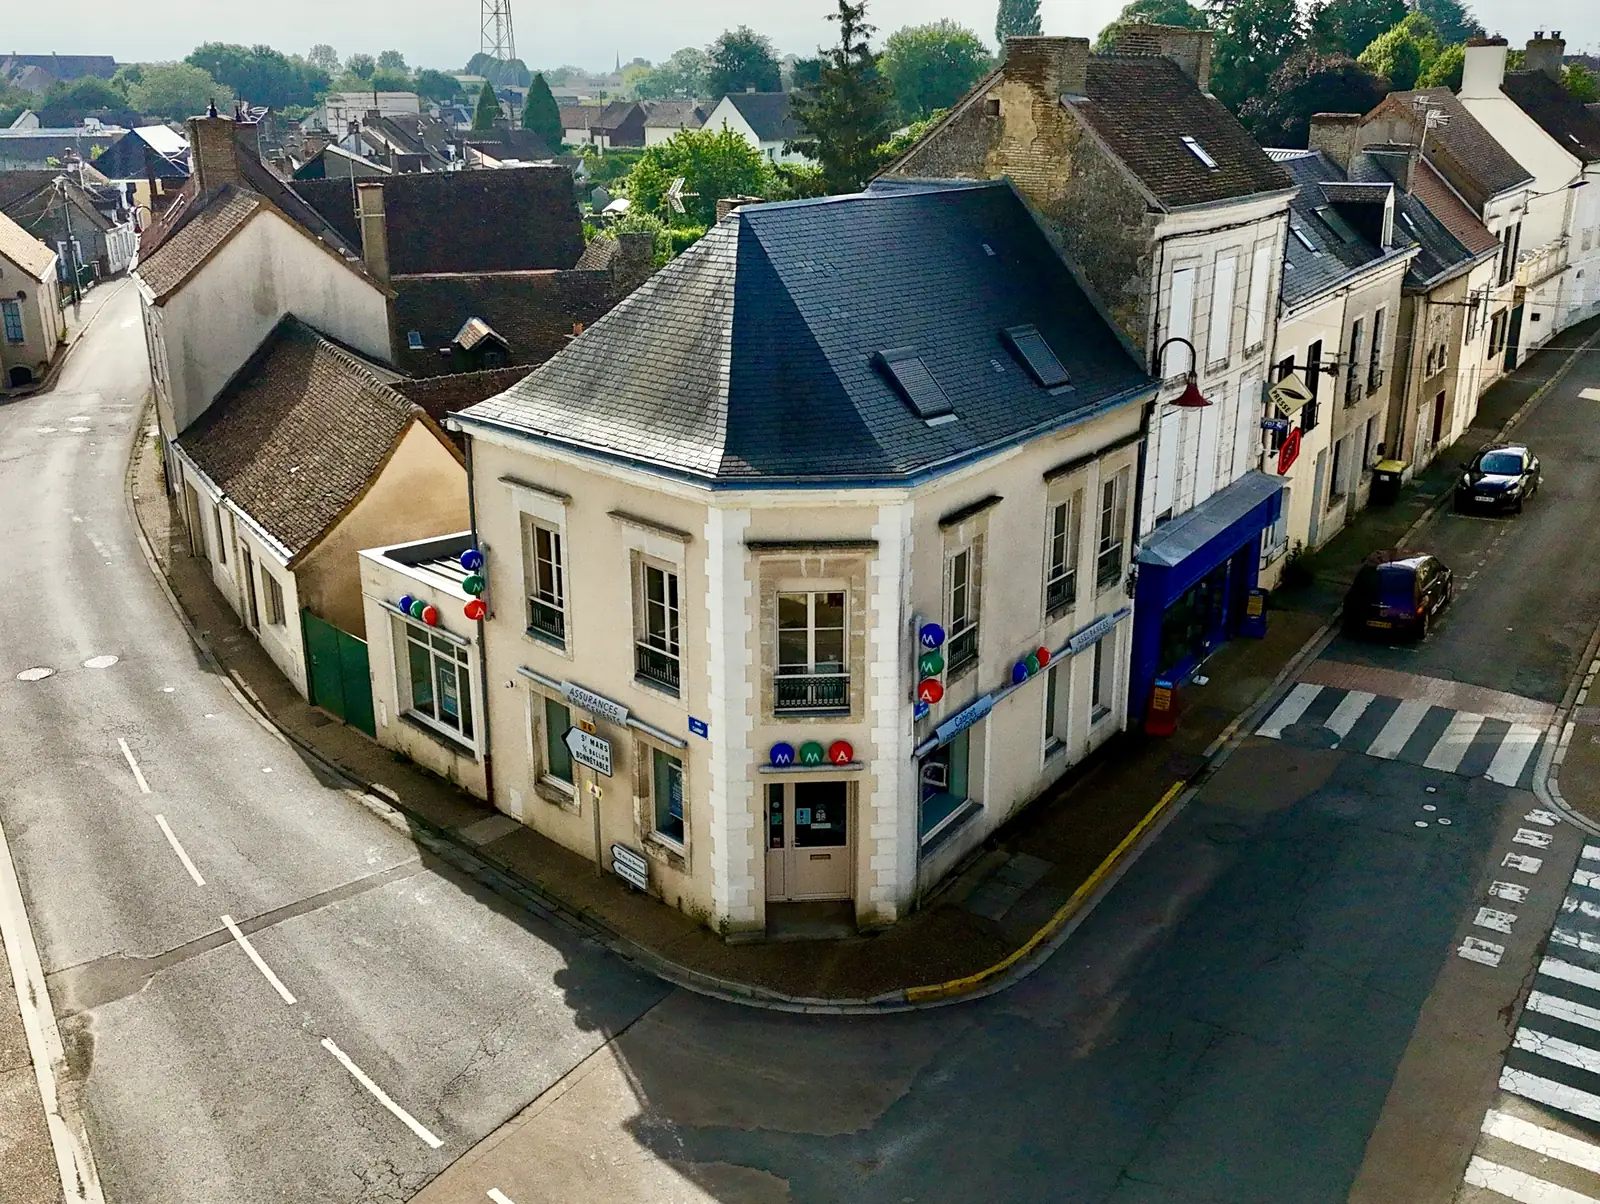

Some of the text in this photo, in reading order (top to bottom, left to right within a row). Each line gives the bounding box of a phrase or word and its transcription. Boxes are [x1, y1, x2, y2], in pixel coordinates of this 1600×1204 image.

[1271, 390, 1292, 414] PRESSE
[569, 687, 619, 716] ASSURANCES
[954, 706, 977, 727] Cabinet
[589, 748, 609, 763] BALLON
[590, 738, 608, 753] MARS
[575, 750, 609, 772] BONNÉTABLE
